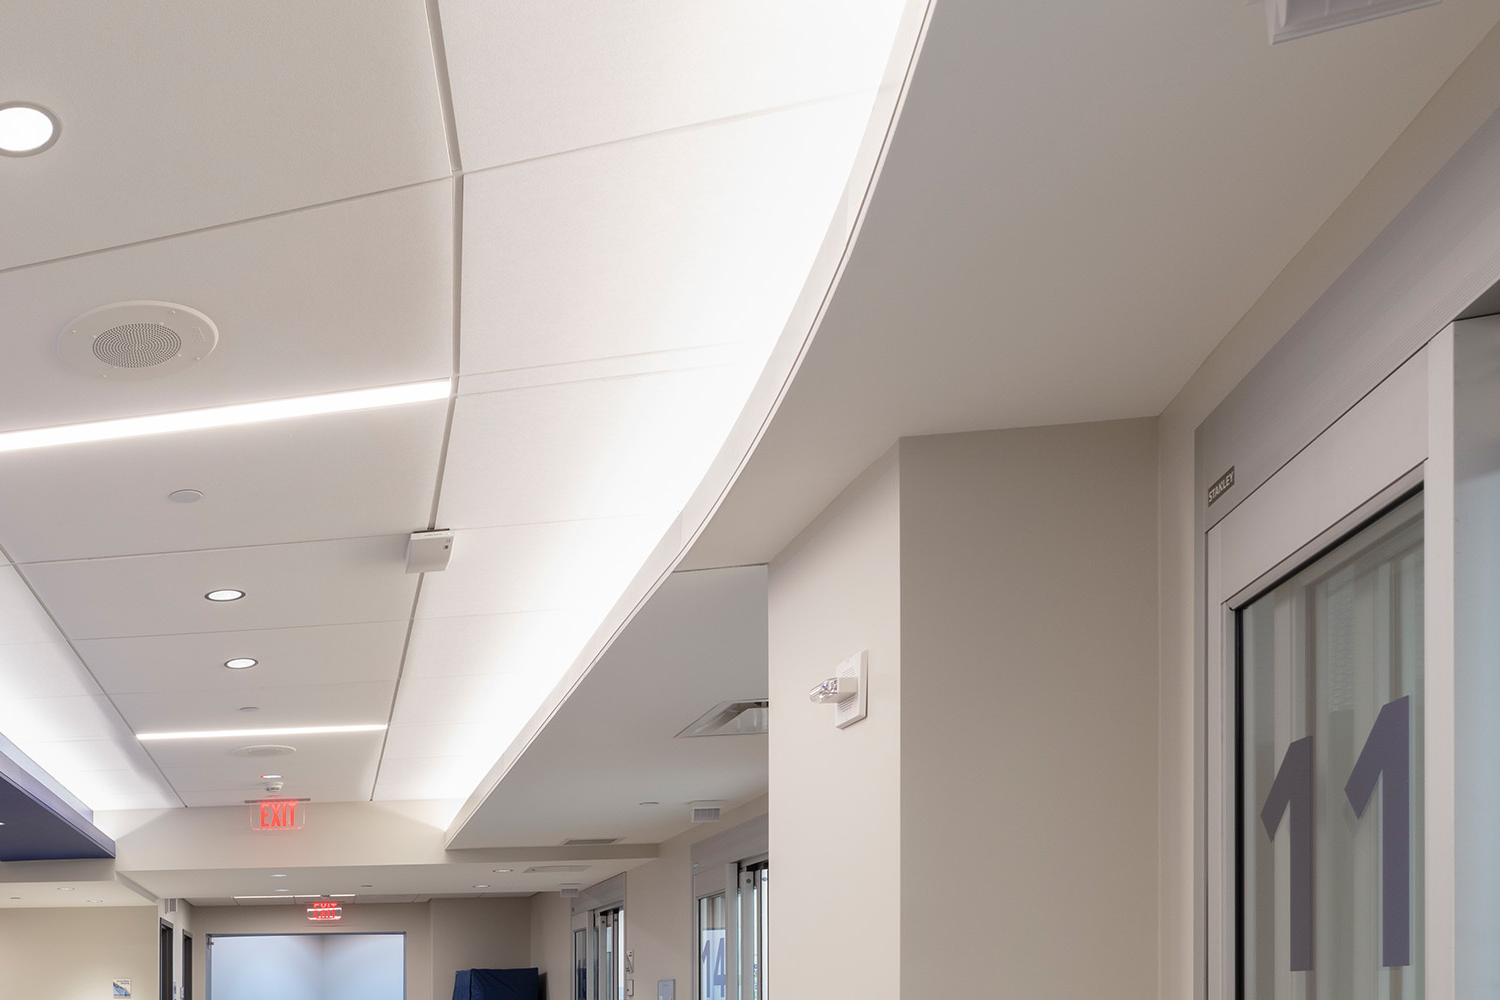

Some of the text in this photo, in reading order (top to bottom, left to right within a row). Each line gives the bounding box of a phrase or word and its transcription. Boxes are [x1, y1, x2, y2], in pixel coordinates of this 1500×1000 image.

[1208, 470, 1234, 503] STANLEY
[260, 801, 298, 828] EXIT
[1260, 695, 1411, 972] 11
[313, 902, 338, 919] EXIT
[702, 937, 726, 998] 14
